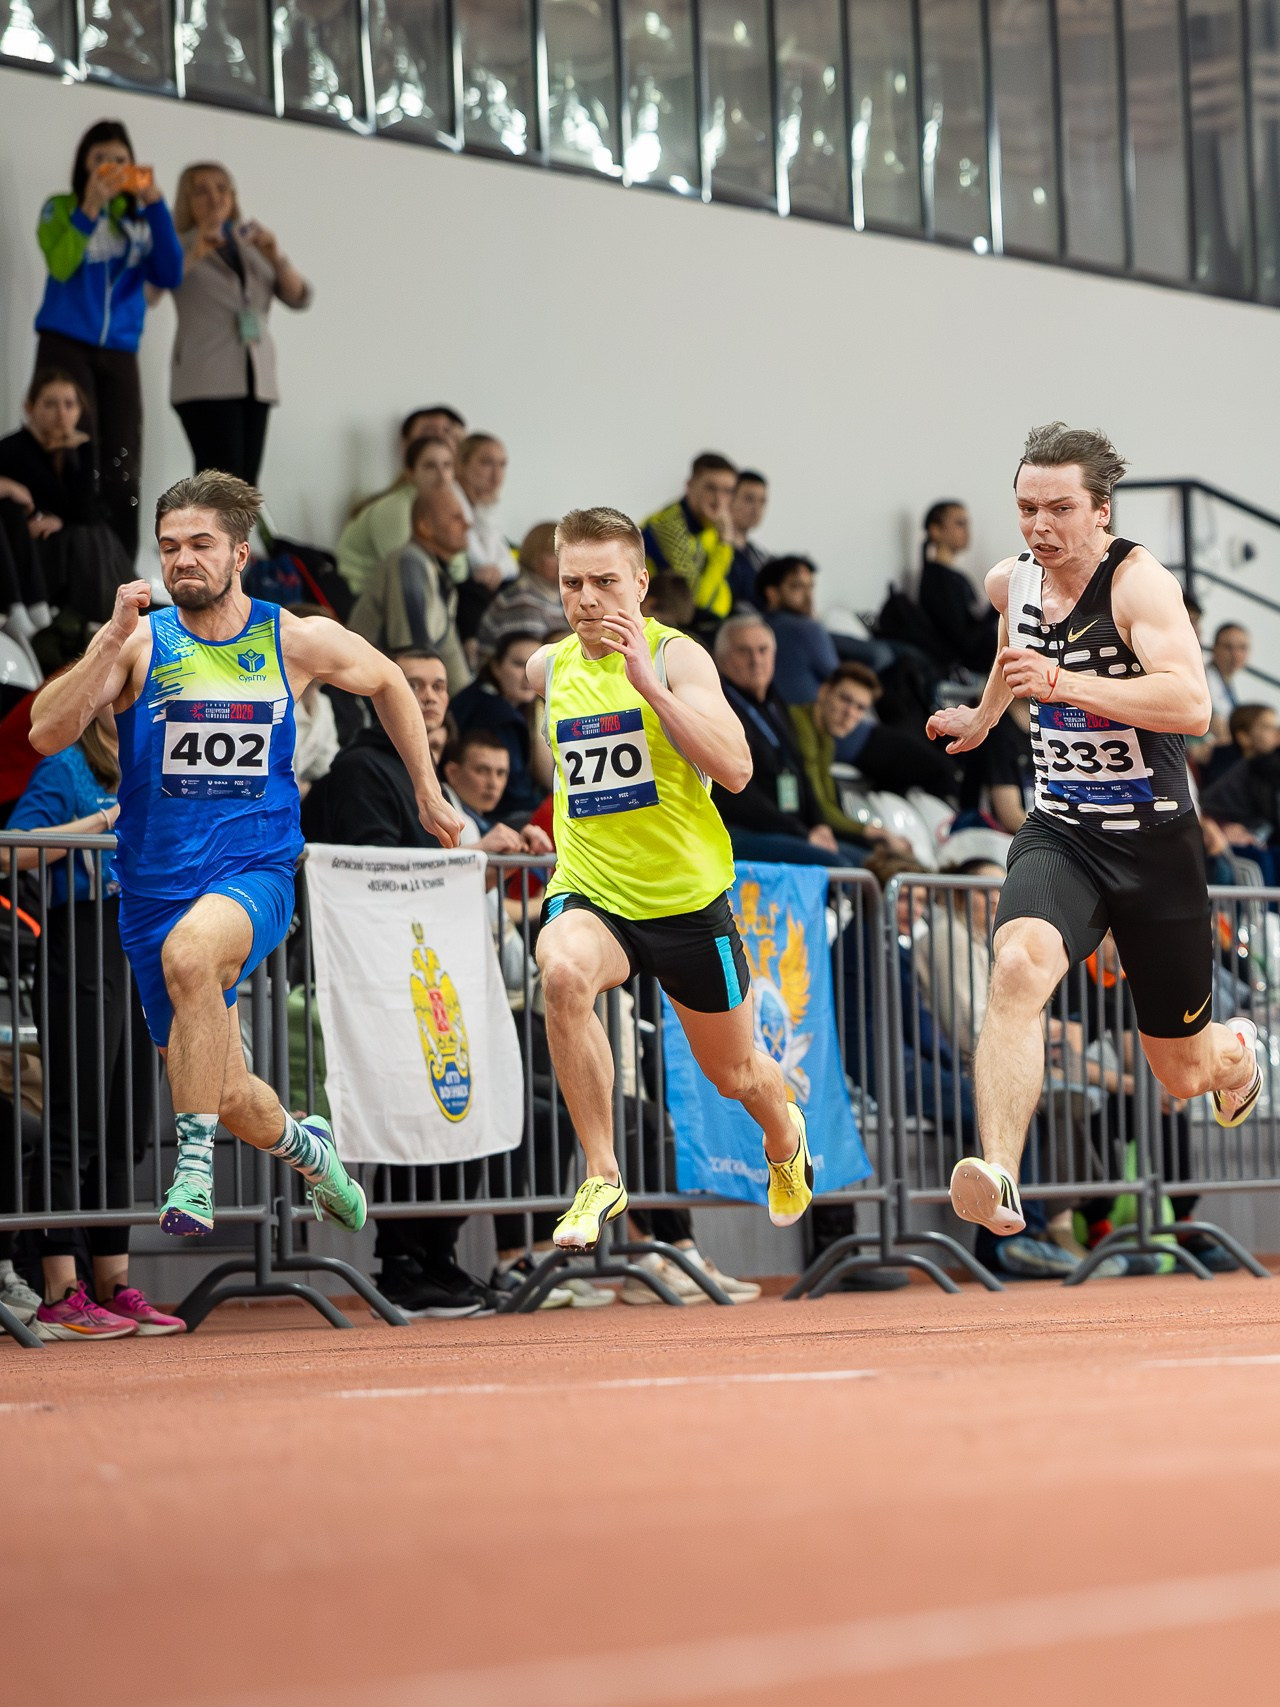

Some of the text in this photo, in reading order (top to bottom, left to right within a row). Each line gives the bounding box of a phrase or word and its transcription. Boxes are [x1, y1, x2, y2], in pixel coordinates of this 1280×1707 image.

[238, 674, 267, 682] СурГПУ
[600, 714, 621, 733] 2026
[170, 732, 265, 768] 402
[564, 742, 643, 786] 270
[1047, 739, 1134, 774] 333
